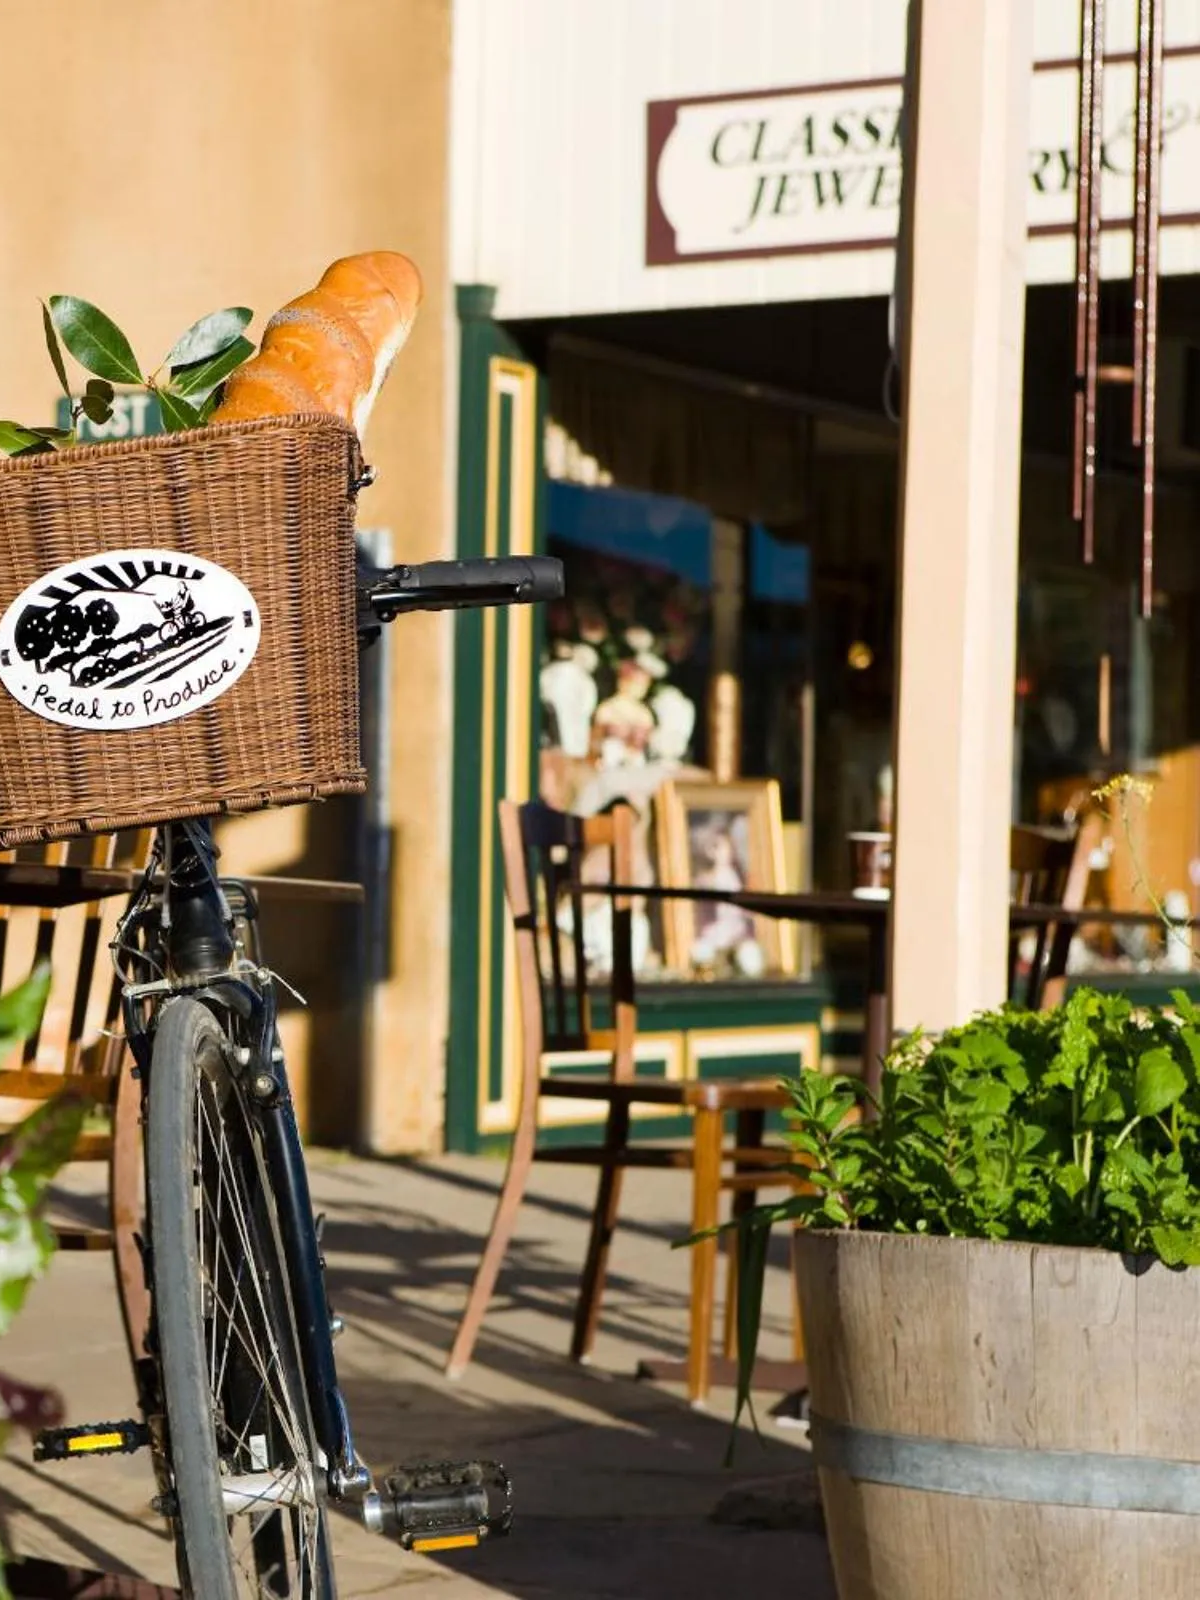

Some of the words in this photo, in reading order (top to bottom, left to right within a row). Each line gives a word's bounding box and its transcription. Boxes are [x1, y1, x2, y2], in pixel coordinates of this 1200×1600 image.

[710, 104, 903, 168] CLASSI
[31, 683, 103, 720] Pedal
[110, 700, 136, 720] to
[142, 658, 237, 716] Produce
